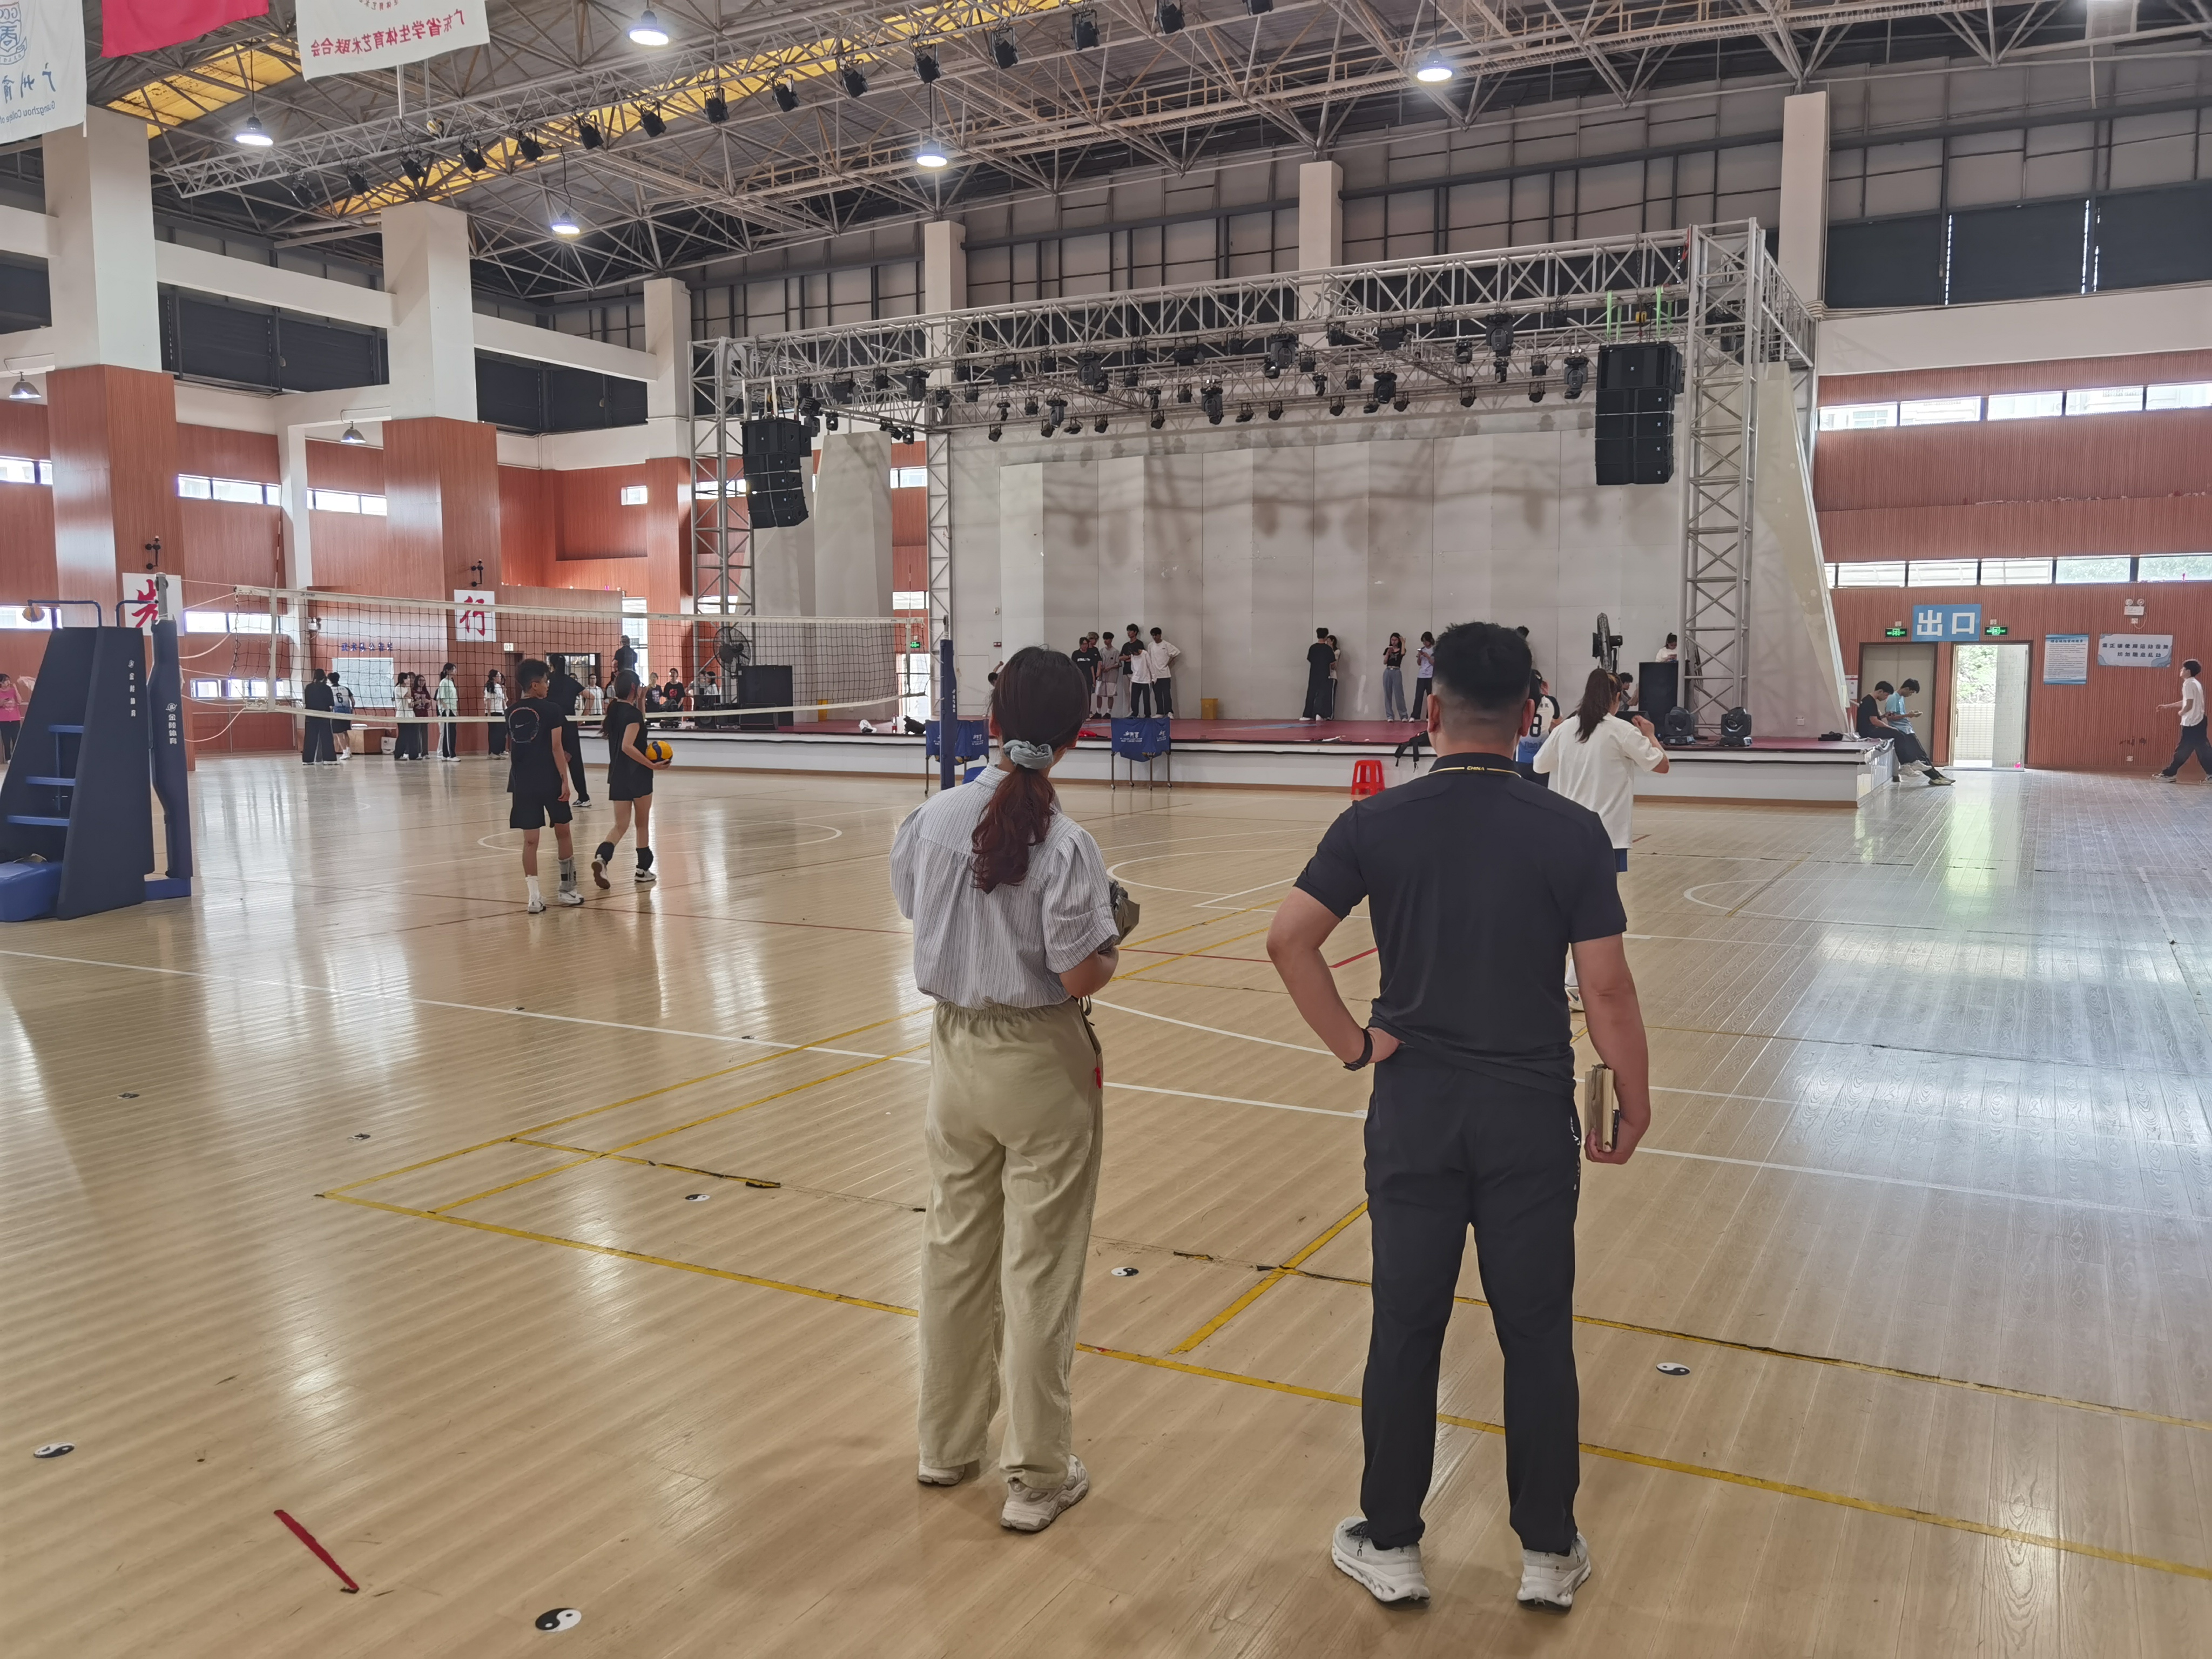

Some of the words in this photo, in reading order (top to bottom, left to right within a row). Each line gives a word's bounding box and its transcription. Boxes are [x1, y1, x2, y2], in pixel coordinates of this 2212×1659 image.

[460, 596, 490, 636] 行
[1917, 610, 1975, 636] 出口
[336, 692, 343, 704] 6
[168, 714, 177, 745] 金陵体育
[1529, 713, 1542, 737] 8
